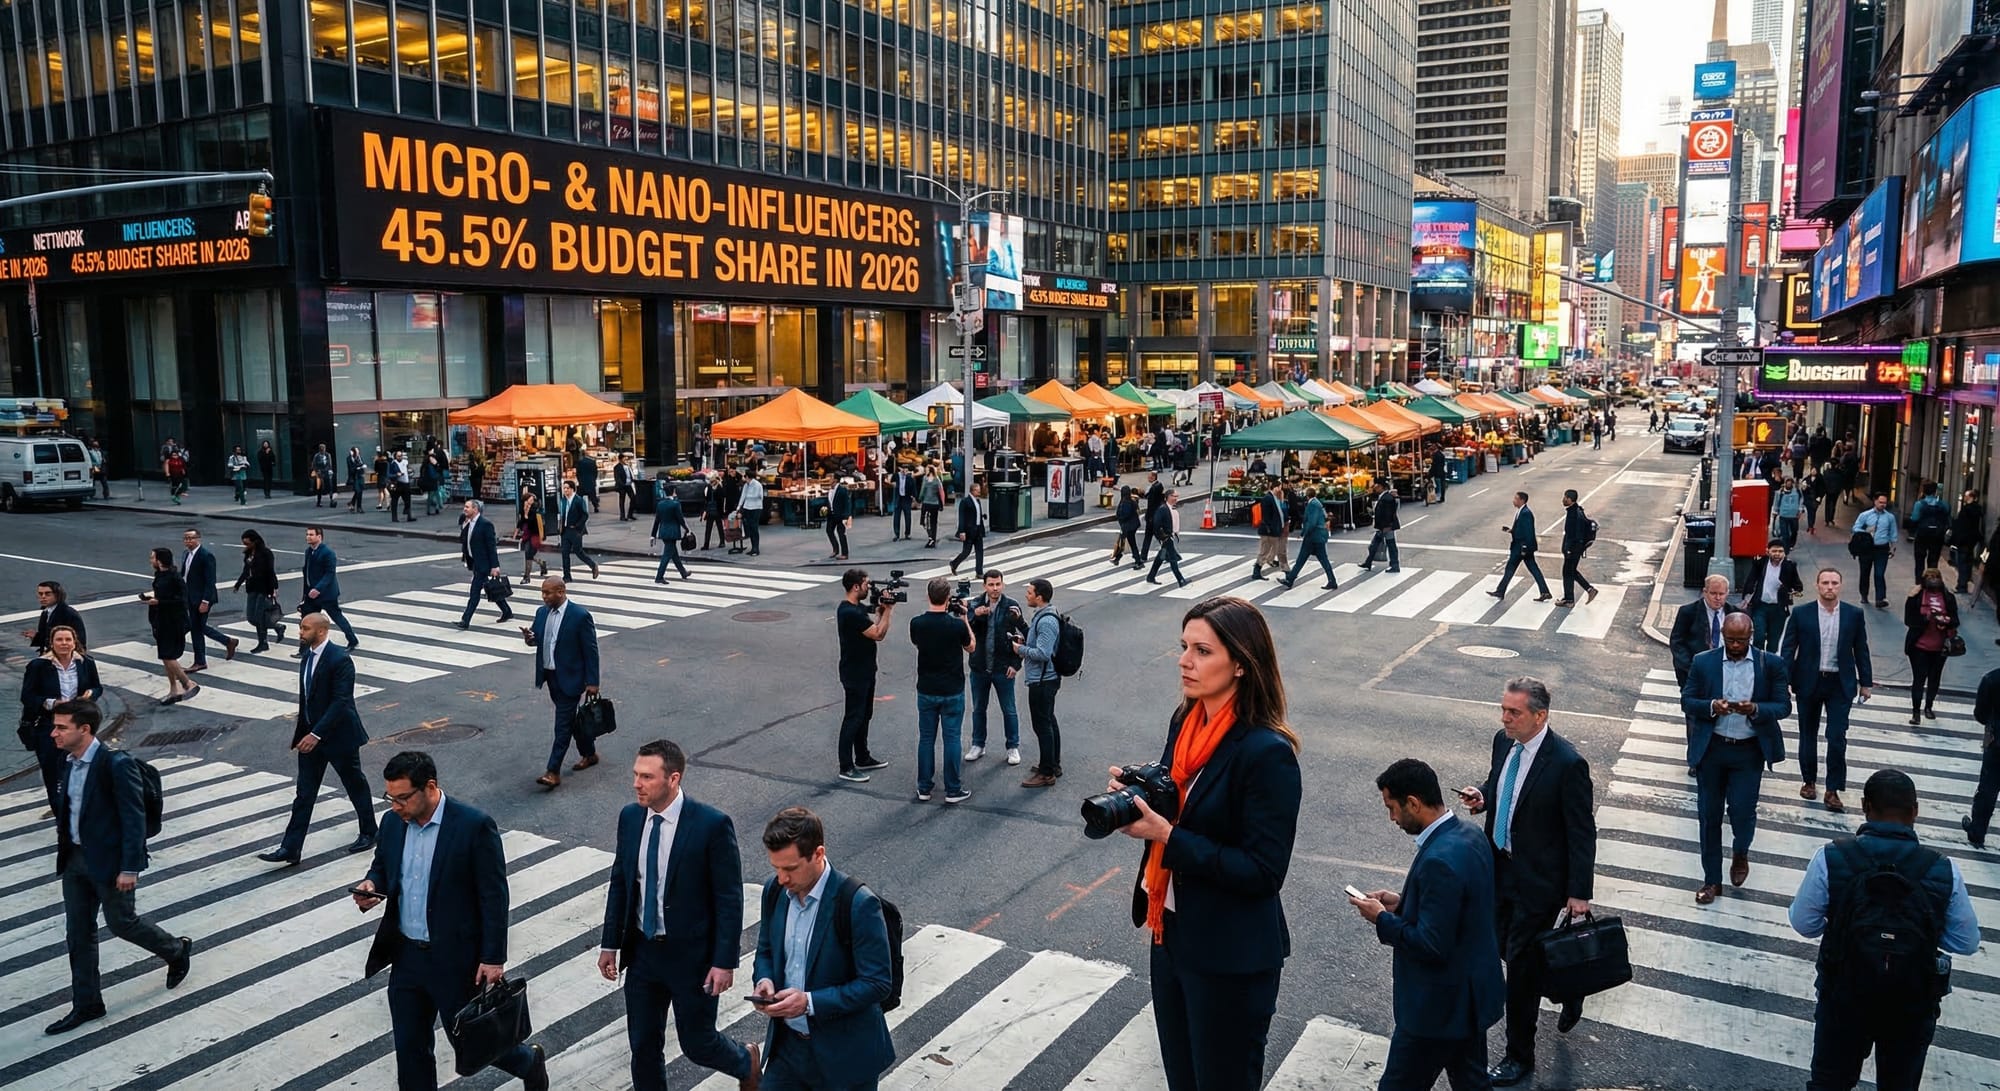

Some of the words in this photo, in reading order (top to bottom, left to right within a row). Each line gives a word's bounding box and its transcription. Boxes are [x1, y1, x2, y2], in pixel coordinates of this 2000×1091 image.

[363, 131, 551, 205] MICRO-
[564, 161, 597, 212] &
[608, 166, 921, 247] NANO-INFLUENCERS:
[33, 229, 85, 251] NETTWORK
[122, 217, 196, 242] INFLUENCERS:
[381, 207, 537, 272] 45.5%
[550, 221, 705, 279] BUDGET
[714, 237, 818, 286] SHARE
[825, 248, 853, 289] IN
[860, 252, 920, 293] 2026
[10, 258, 21, 278] IN
[23, 256, 48, 278] 2026
[71, 252, 105, 273] 45.5%
[107, 246, 153, 271] BUDGET
[155, 242, 198, 267] SHARE
[200, 241, 215, 264] IN
[217, 237, 250, 262] 2026
[1736, 353, 1755, 361] WAY
